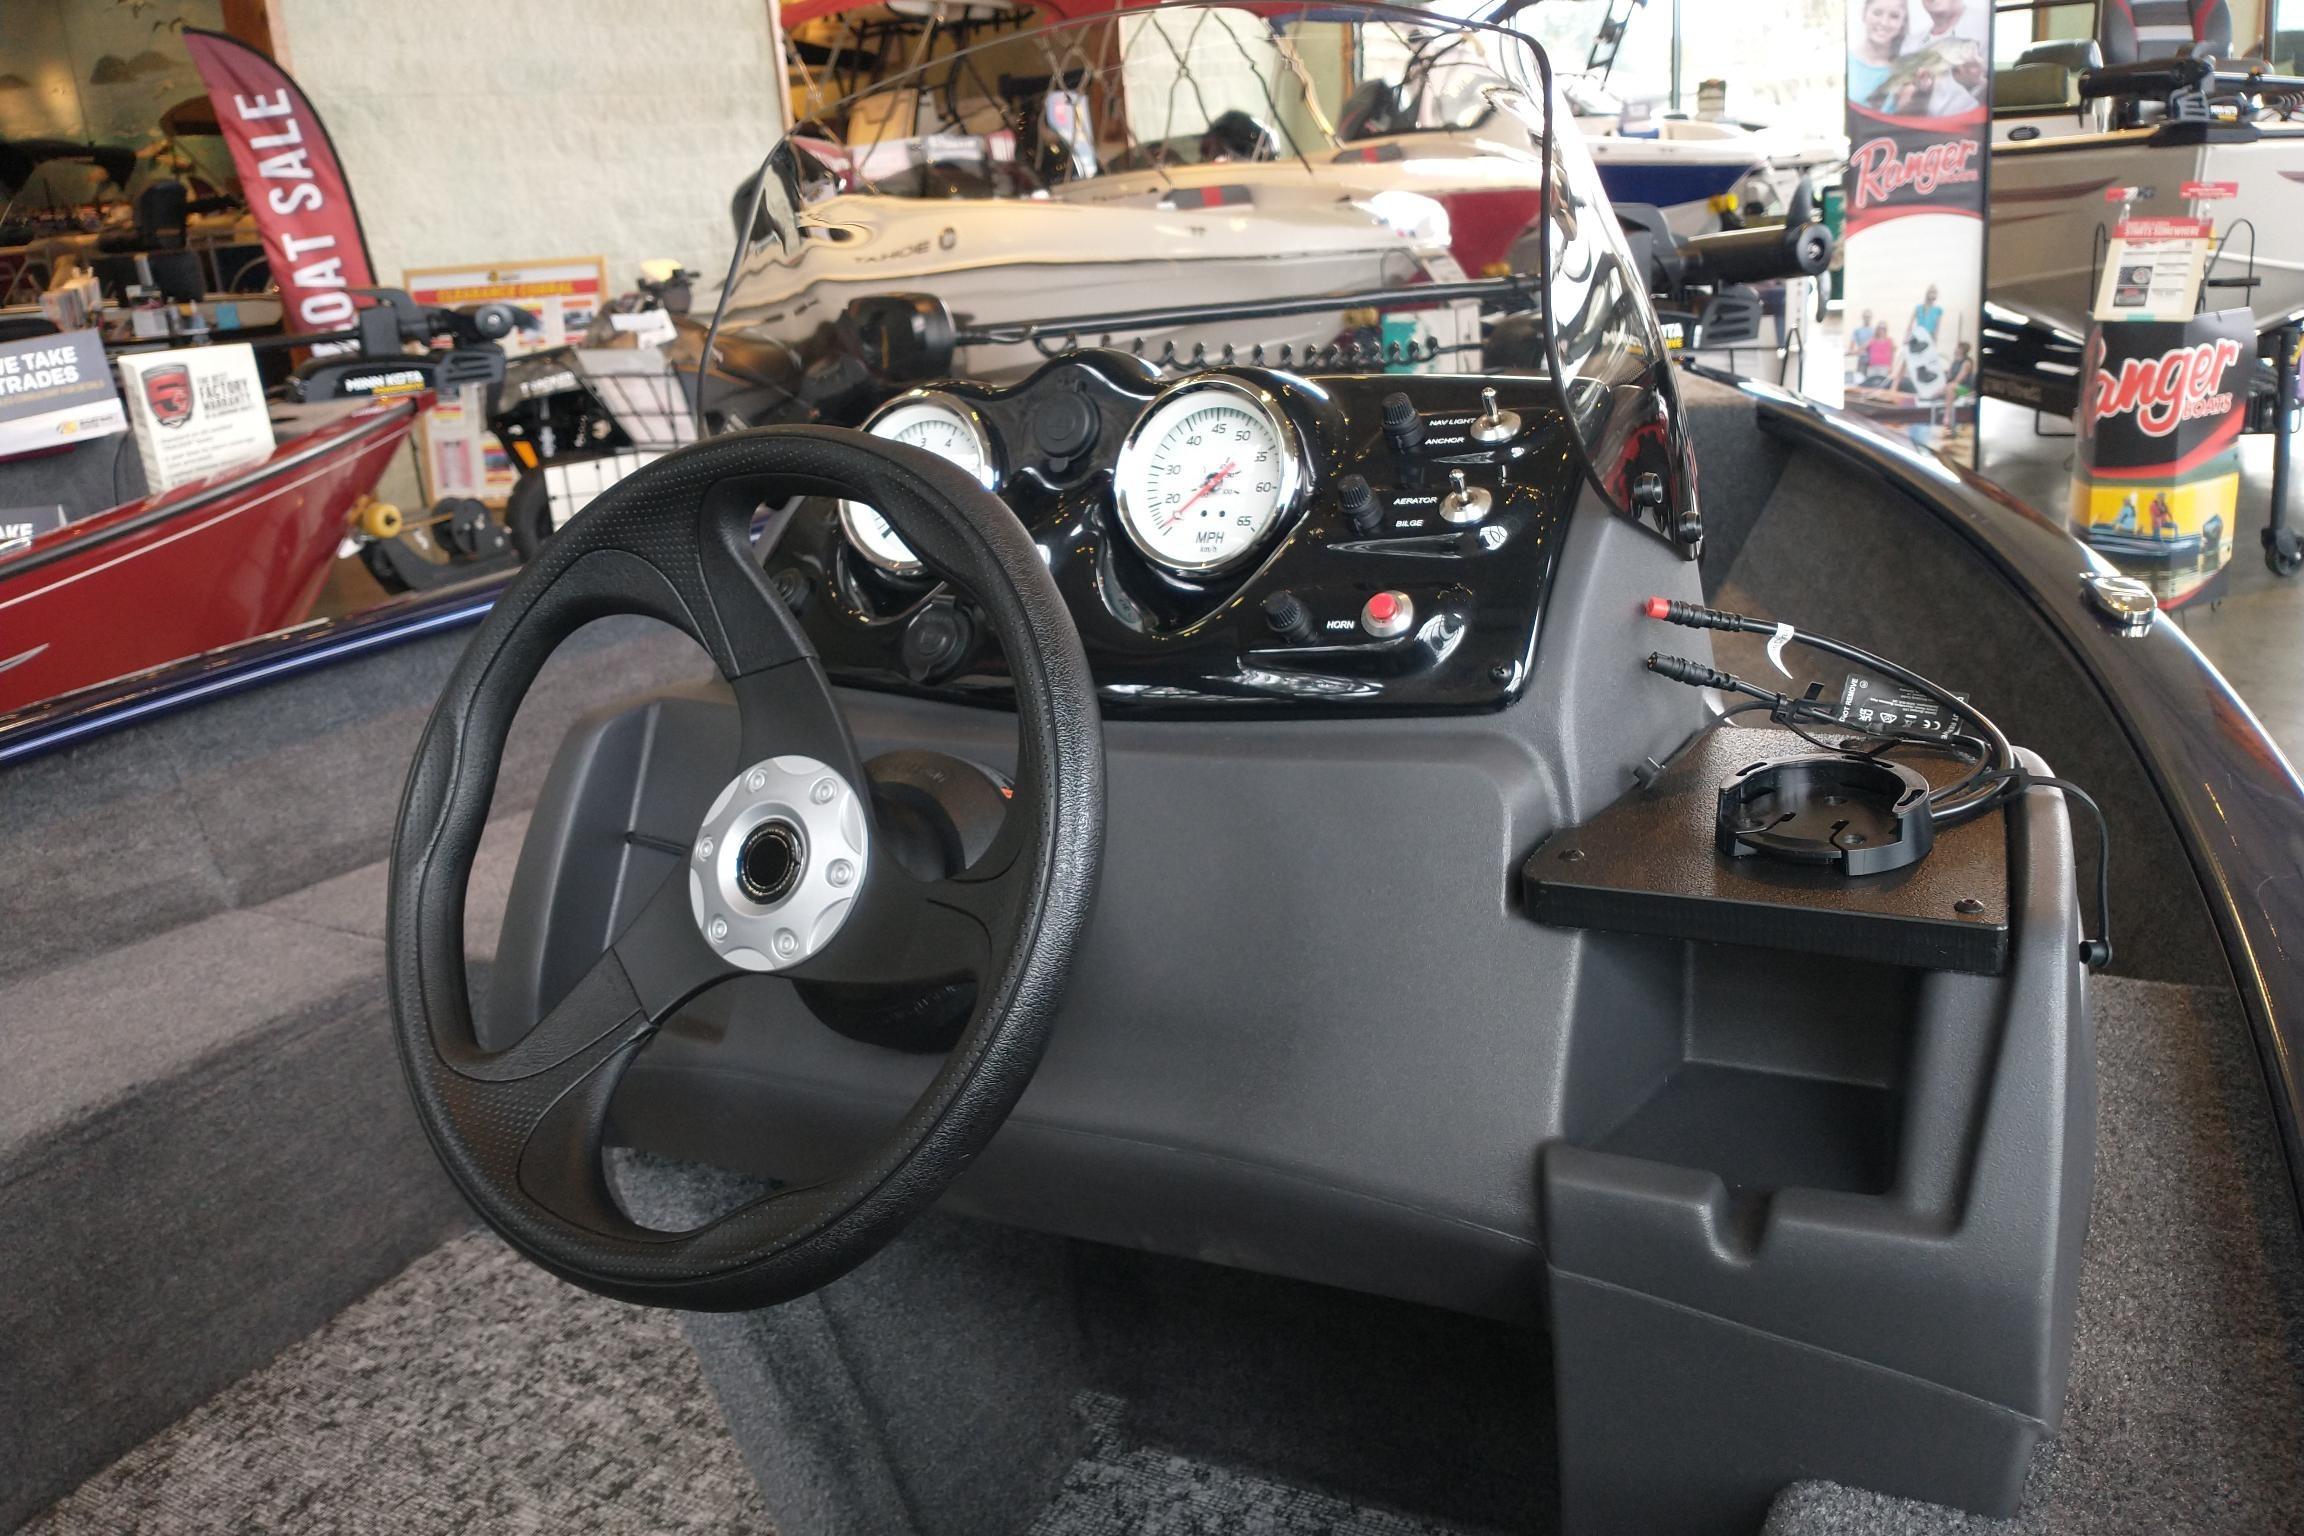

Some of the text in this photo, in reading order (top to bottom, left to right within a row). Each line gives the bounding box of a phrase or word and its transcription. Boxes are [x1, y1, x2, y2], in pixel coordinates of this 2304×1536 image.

[234, 88, 324, 215] SALE
[1849, 137, 1979, 209] Ranger
[21, 346, 78, 370] TAKE
[2181, 392, 2233, 421] BOATS
[1448, 417, 1476, 425] LIGHT
[1211, 423, 1227, 434] 45
[1186, 435, 1202, 446] 40
[1234, 430, 1250, 441] 50
[1424, 437, 1465, 445] ANCHOR
[1165, 464, 1181, 475] 30
[1255, 481, 1271, 493] 60
[1165, 493, 1181, 504] 20
[1392, 496, 1438, 505] AERATOR
[1236, 515, 1252, 527] 65
[1395, 519, 1425, 528] BILGE
[1195, 531, 1225, 544] MPH
[1326, 620, 1355, 629] HORN
[1845, 677, 1858, 706] REMOVE
